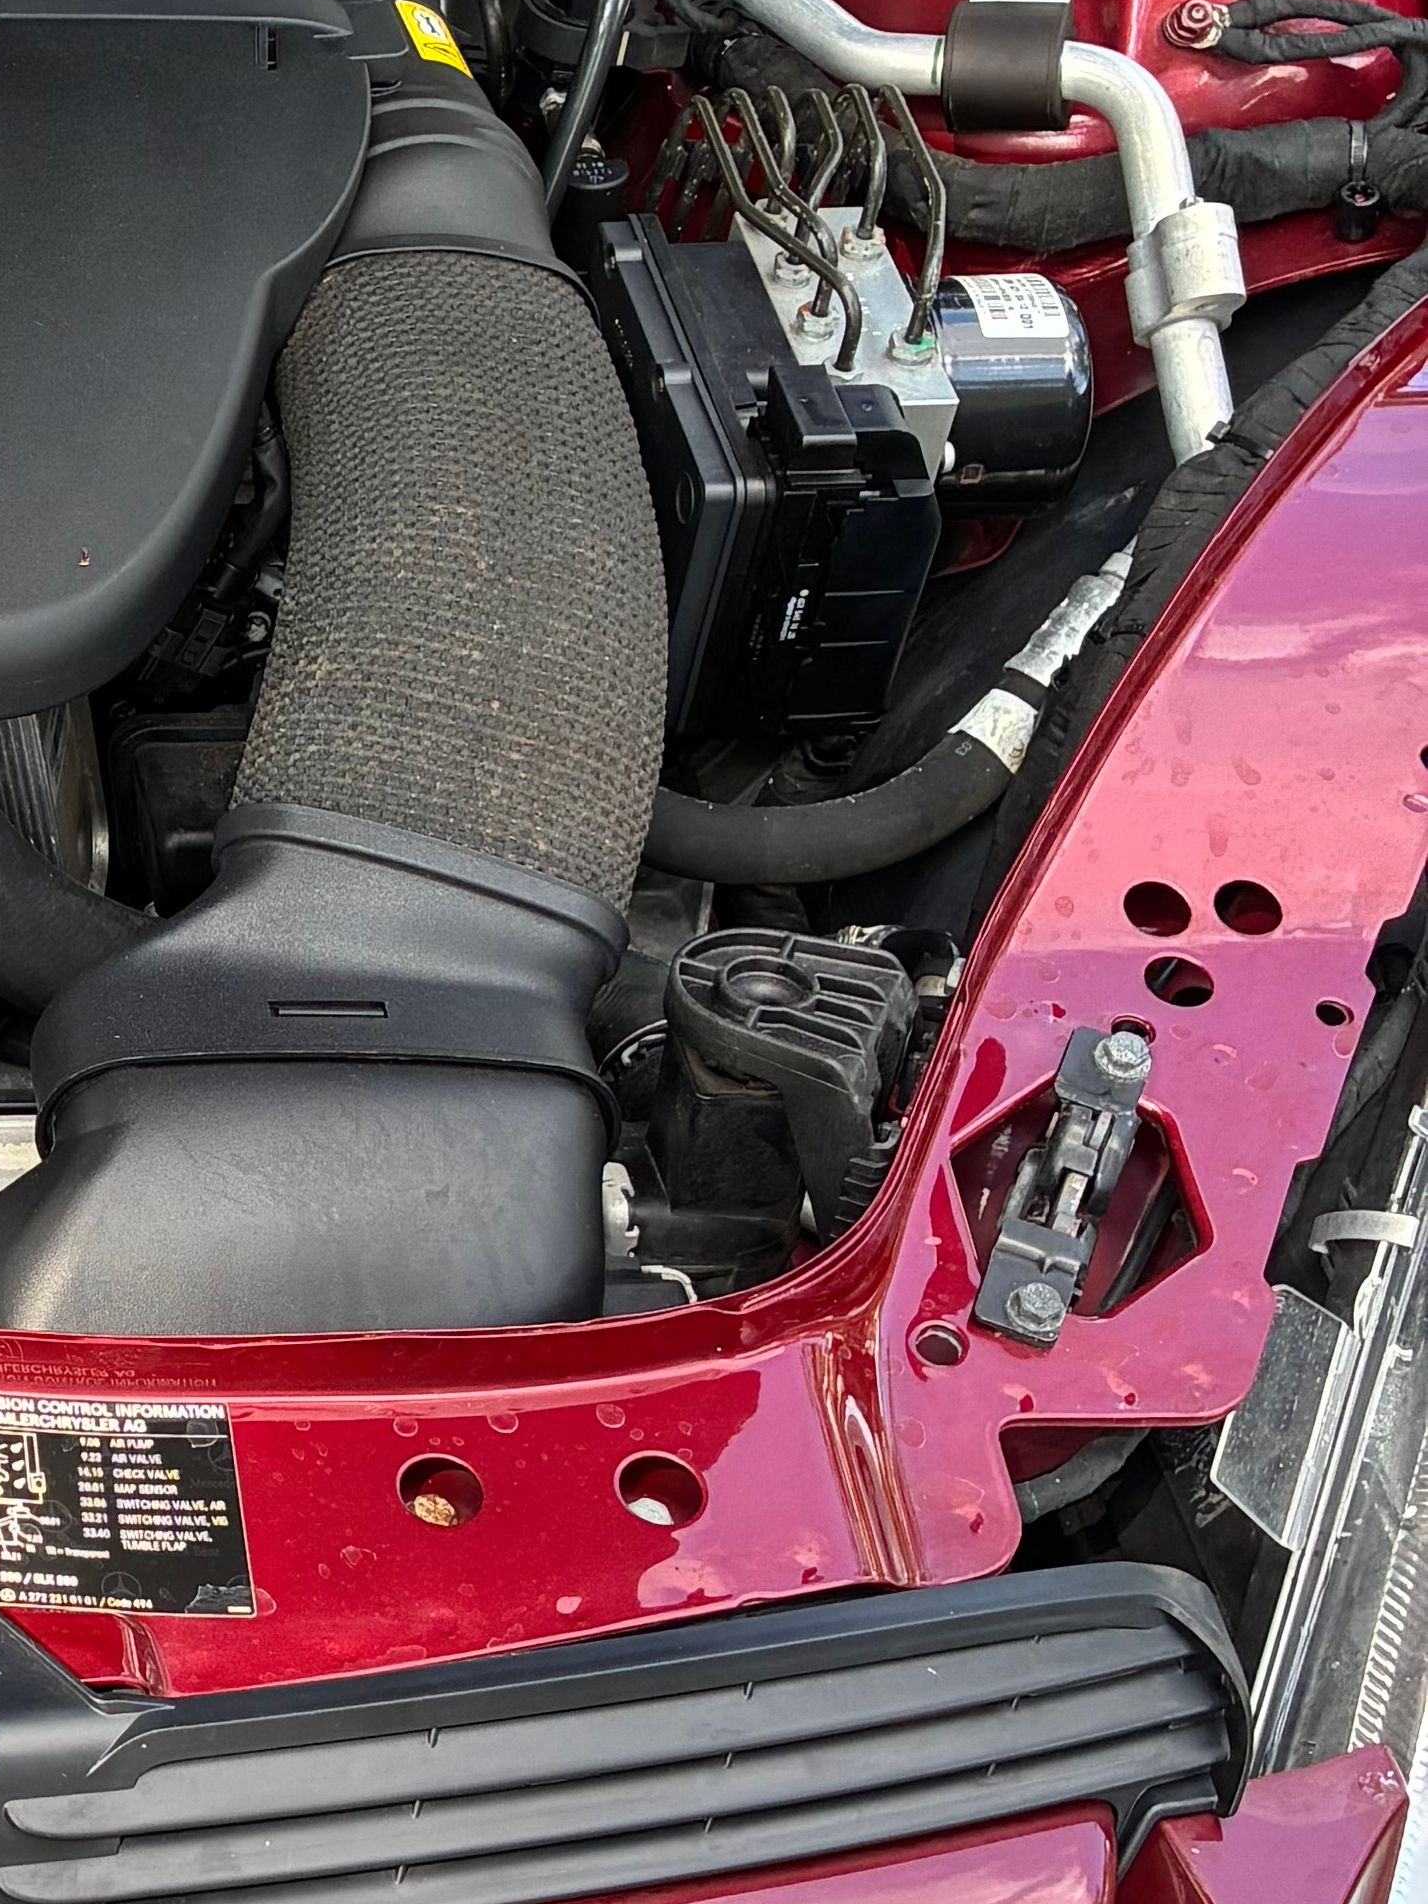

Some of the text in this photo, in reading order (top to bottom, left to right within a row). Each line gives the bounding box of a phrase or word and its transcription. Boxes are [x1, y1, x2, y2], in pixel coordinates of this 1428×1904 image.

[37, 1399, 113, 1417] CONTROL
[113, 1402, 225, 1419] INFORMATION
[123, 1419, 147, 1433] AG
[127, 1439, 154, 1449] PUMP
[128, 1454, 162, 1464] VALVE
[113, 1468, 145, 1479] CHECK
[146, 1469, 180, 1480] VALVE
[138, 1484, 178, 1495] SENSOR
[116, 1498, 171, 1510] SWITCHING
[118, 1514, 173, 1526] SWITCHING
[120, 1529, 175, 1542] SWITCHING
[161, 1541, 187, 1551] FLAP
